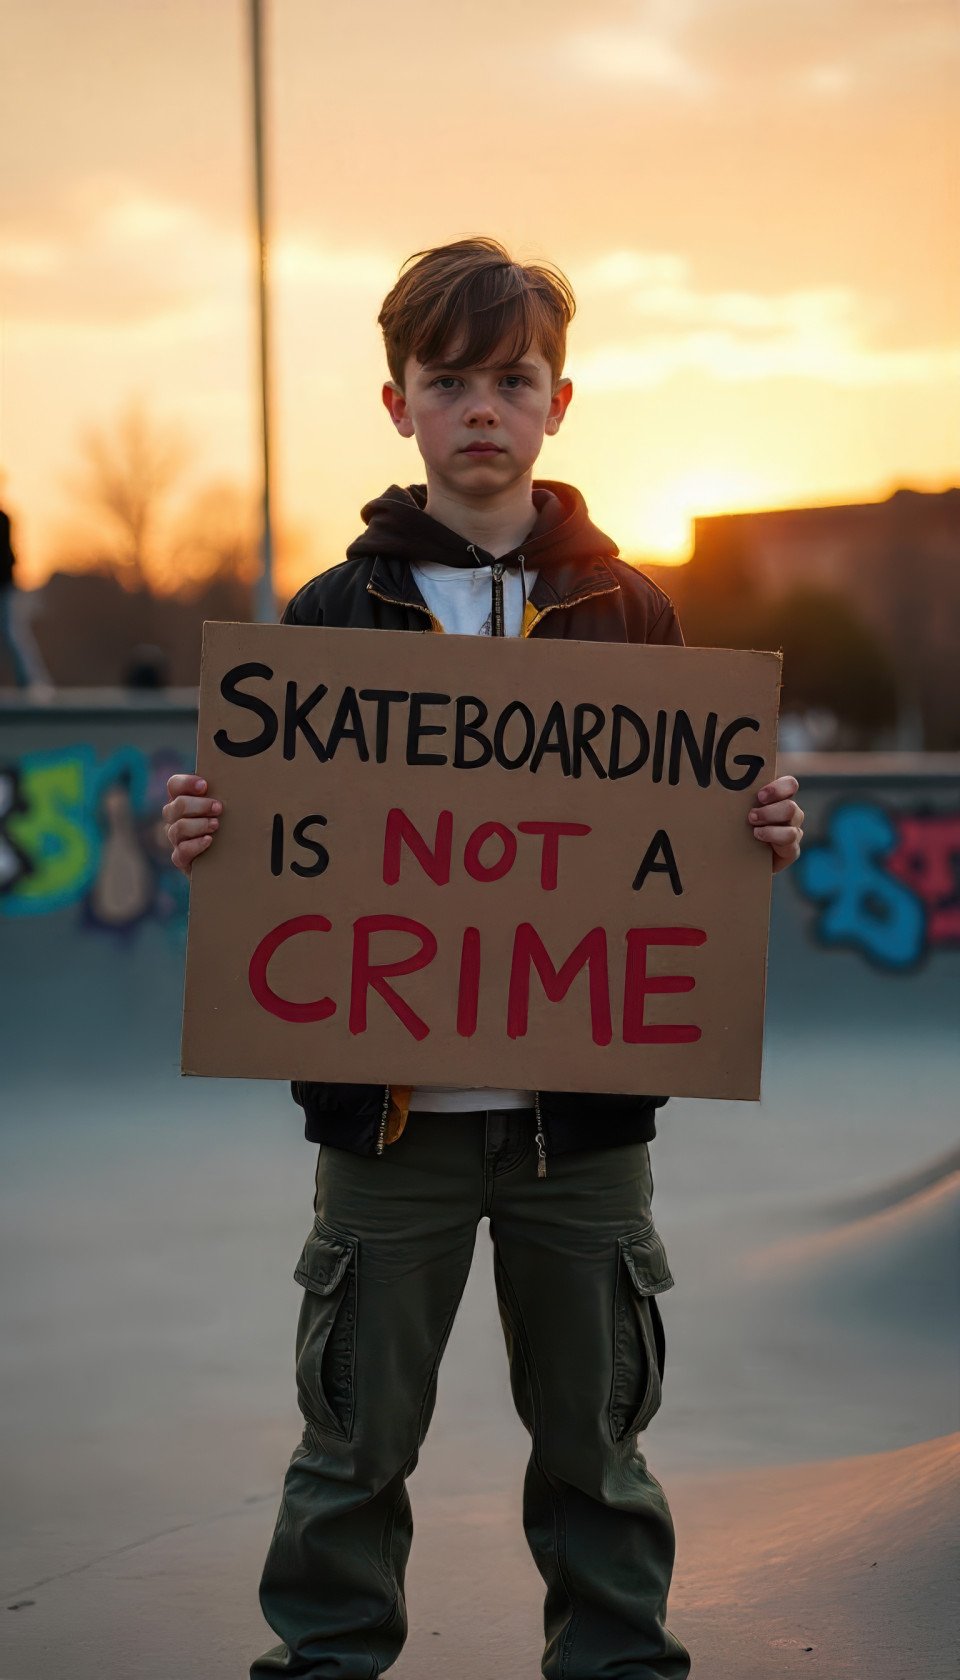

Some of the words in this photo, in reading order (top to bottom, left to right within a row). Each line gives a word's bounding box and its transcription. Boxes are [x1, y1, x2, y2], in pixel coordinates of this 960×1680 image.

[213, 661, 765, 791] SKATEBOARDING
[270, 813, 330, 878] IS
[382, 808, 592, 891] NOT
[631, 829, 684, 896] A
[248, 914, 708, 1047] CRIME
